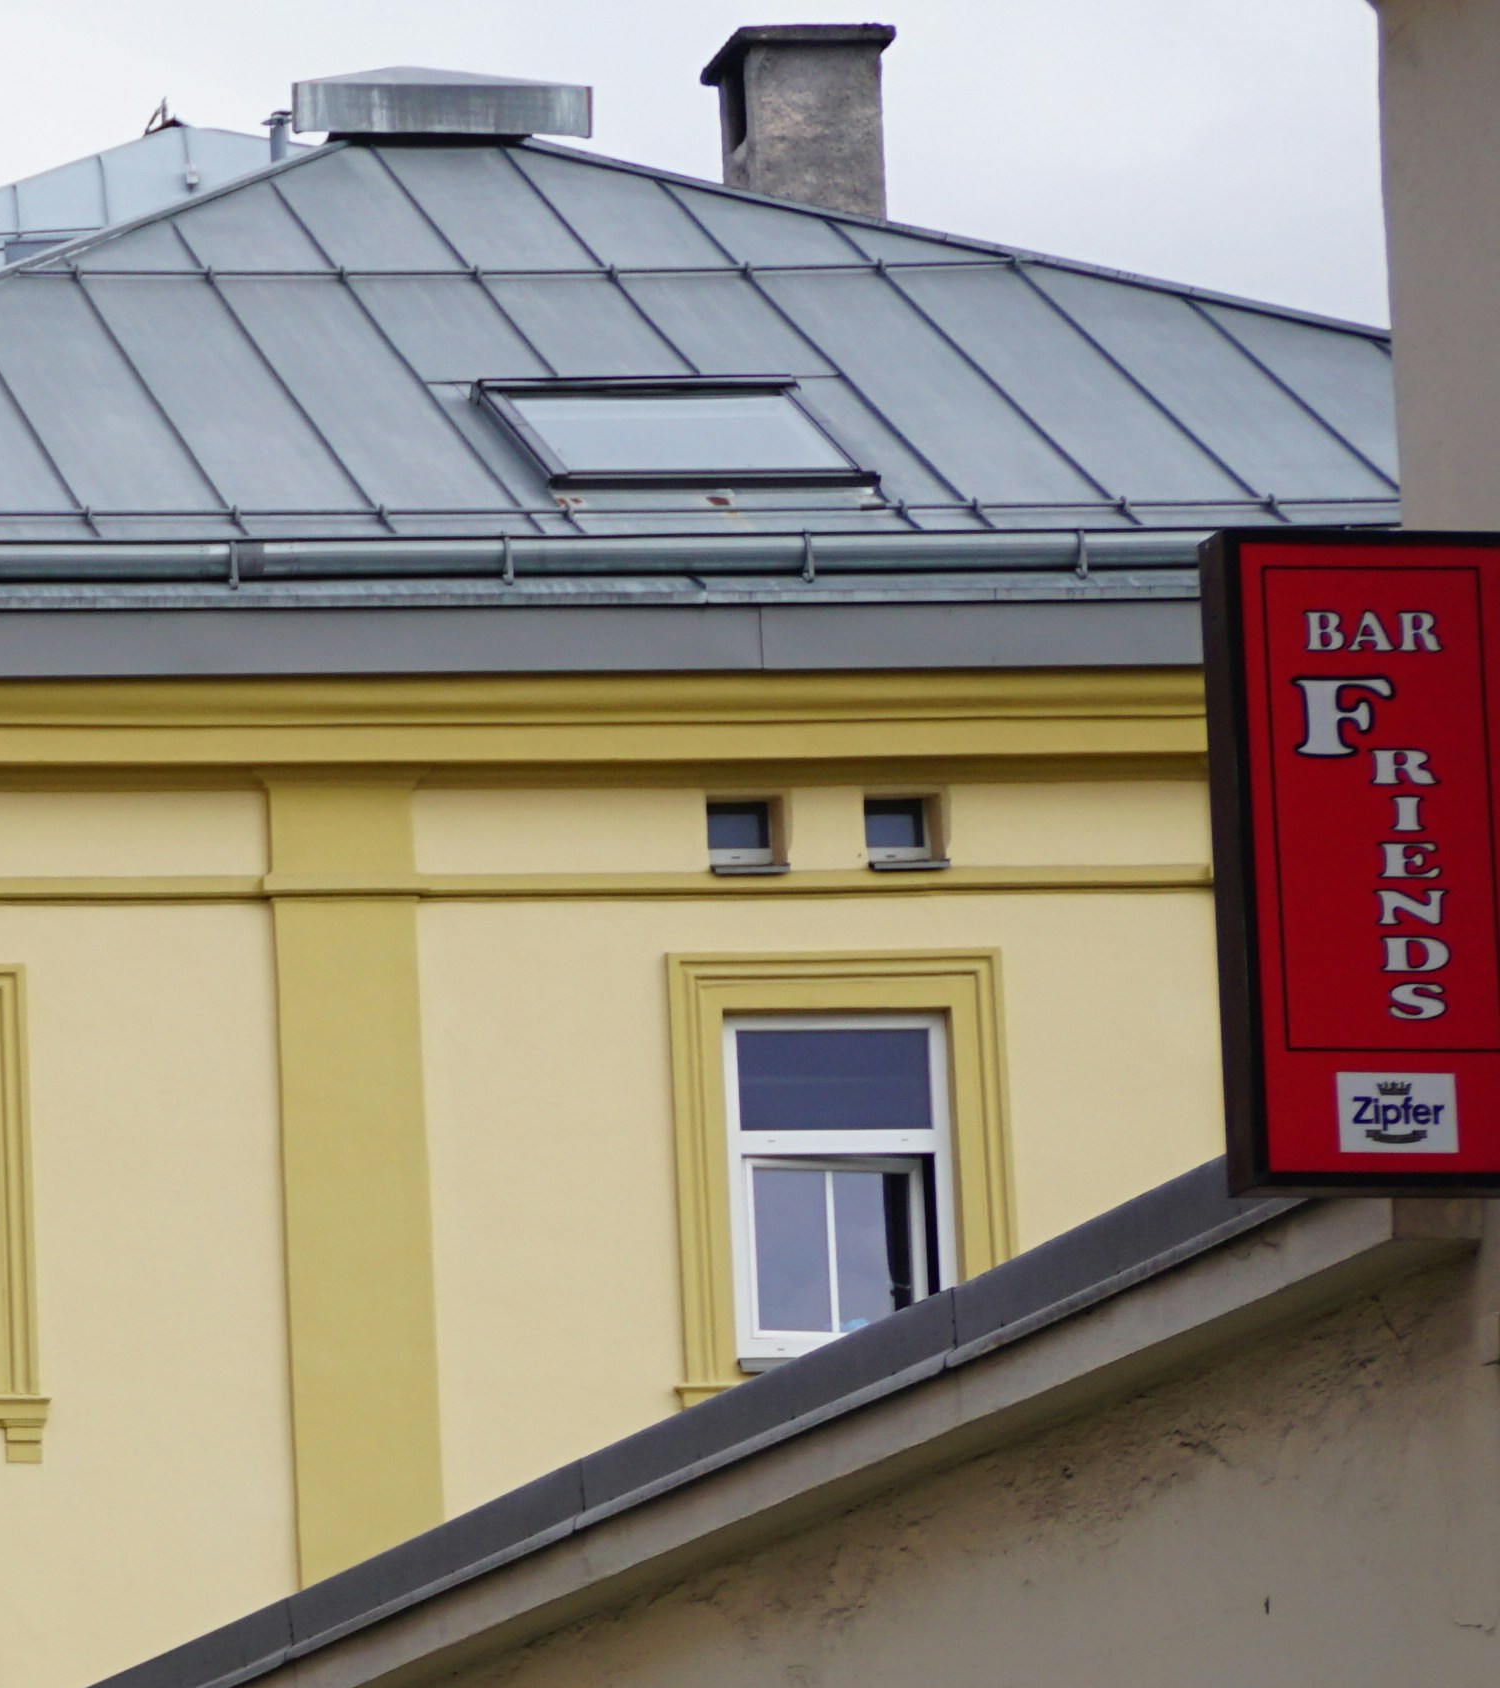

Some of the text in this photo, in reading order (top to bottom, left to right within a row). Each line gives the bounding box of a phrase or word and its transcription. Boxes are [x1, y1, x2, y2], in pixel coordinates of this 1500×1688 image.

[1303, 610, 1442, 651] BAR
[1291, 676, 1451, 1020] FRIENDS
[1352, 1096, 1445, 1131] Zipfer
